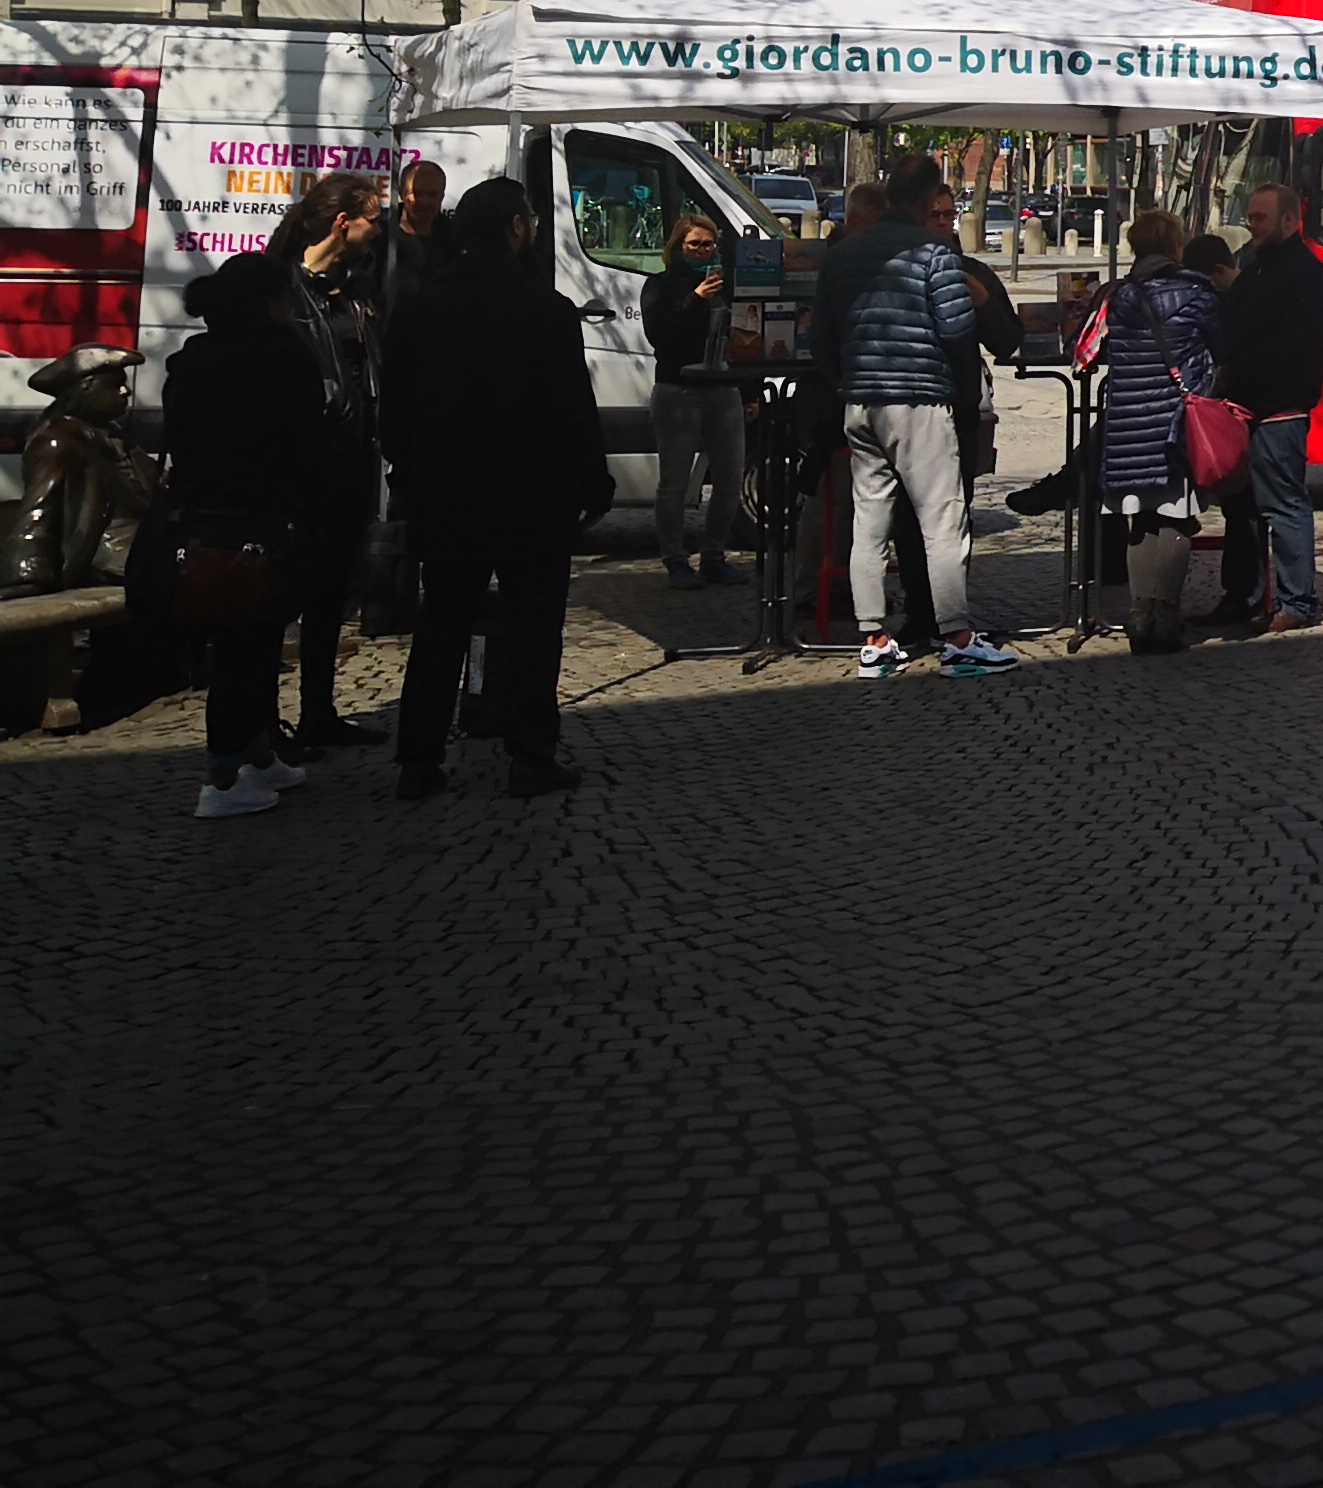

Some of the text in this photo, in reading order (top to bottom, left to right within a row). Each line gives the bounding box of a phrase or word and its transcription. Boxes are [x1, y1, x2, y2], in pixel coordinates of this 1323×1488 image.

[5, 95, 112, 110] Wie kann es
[4, 116, 26, 129] du
[66, 119, 128, 133] ganzes
[14, 138, 106, 153] erschaffst,
[209, 141, 421, 171] KIRCHENSTAA?
[1, 158, 103, 173] Personal so
[7, 181, 126, 196] nicht im Griff
[226, 170, 291, 194] NEIN
[159, 199, 182, 212] 100
[183, 200, 229, 213] JAHRE
